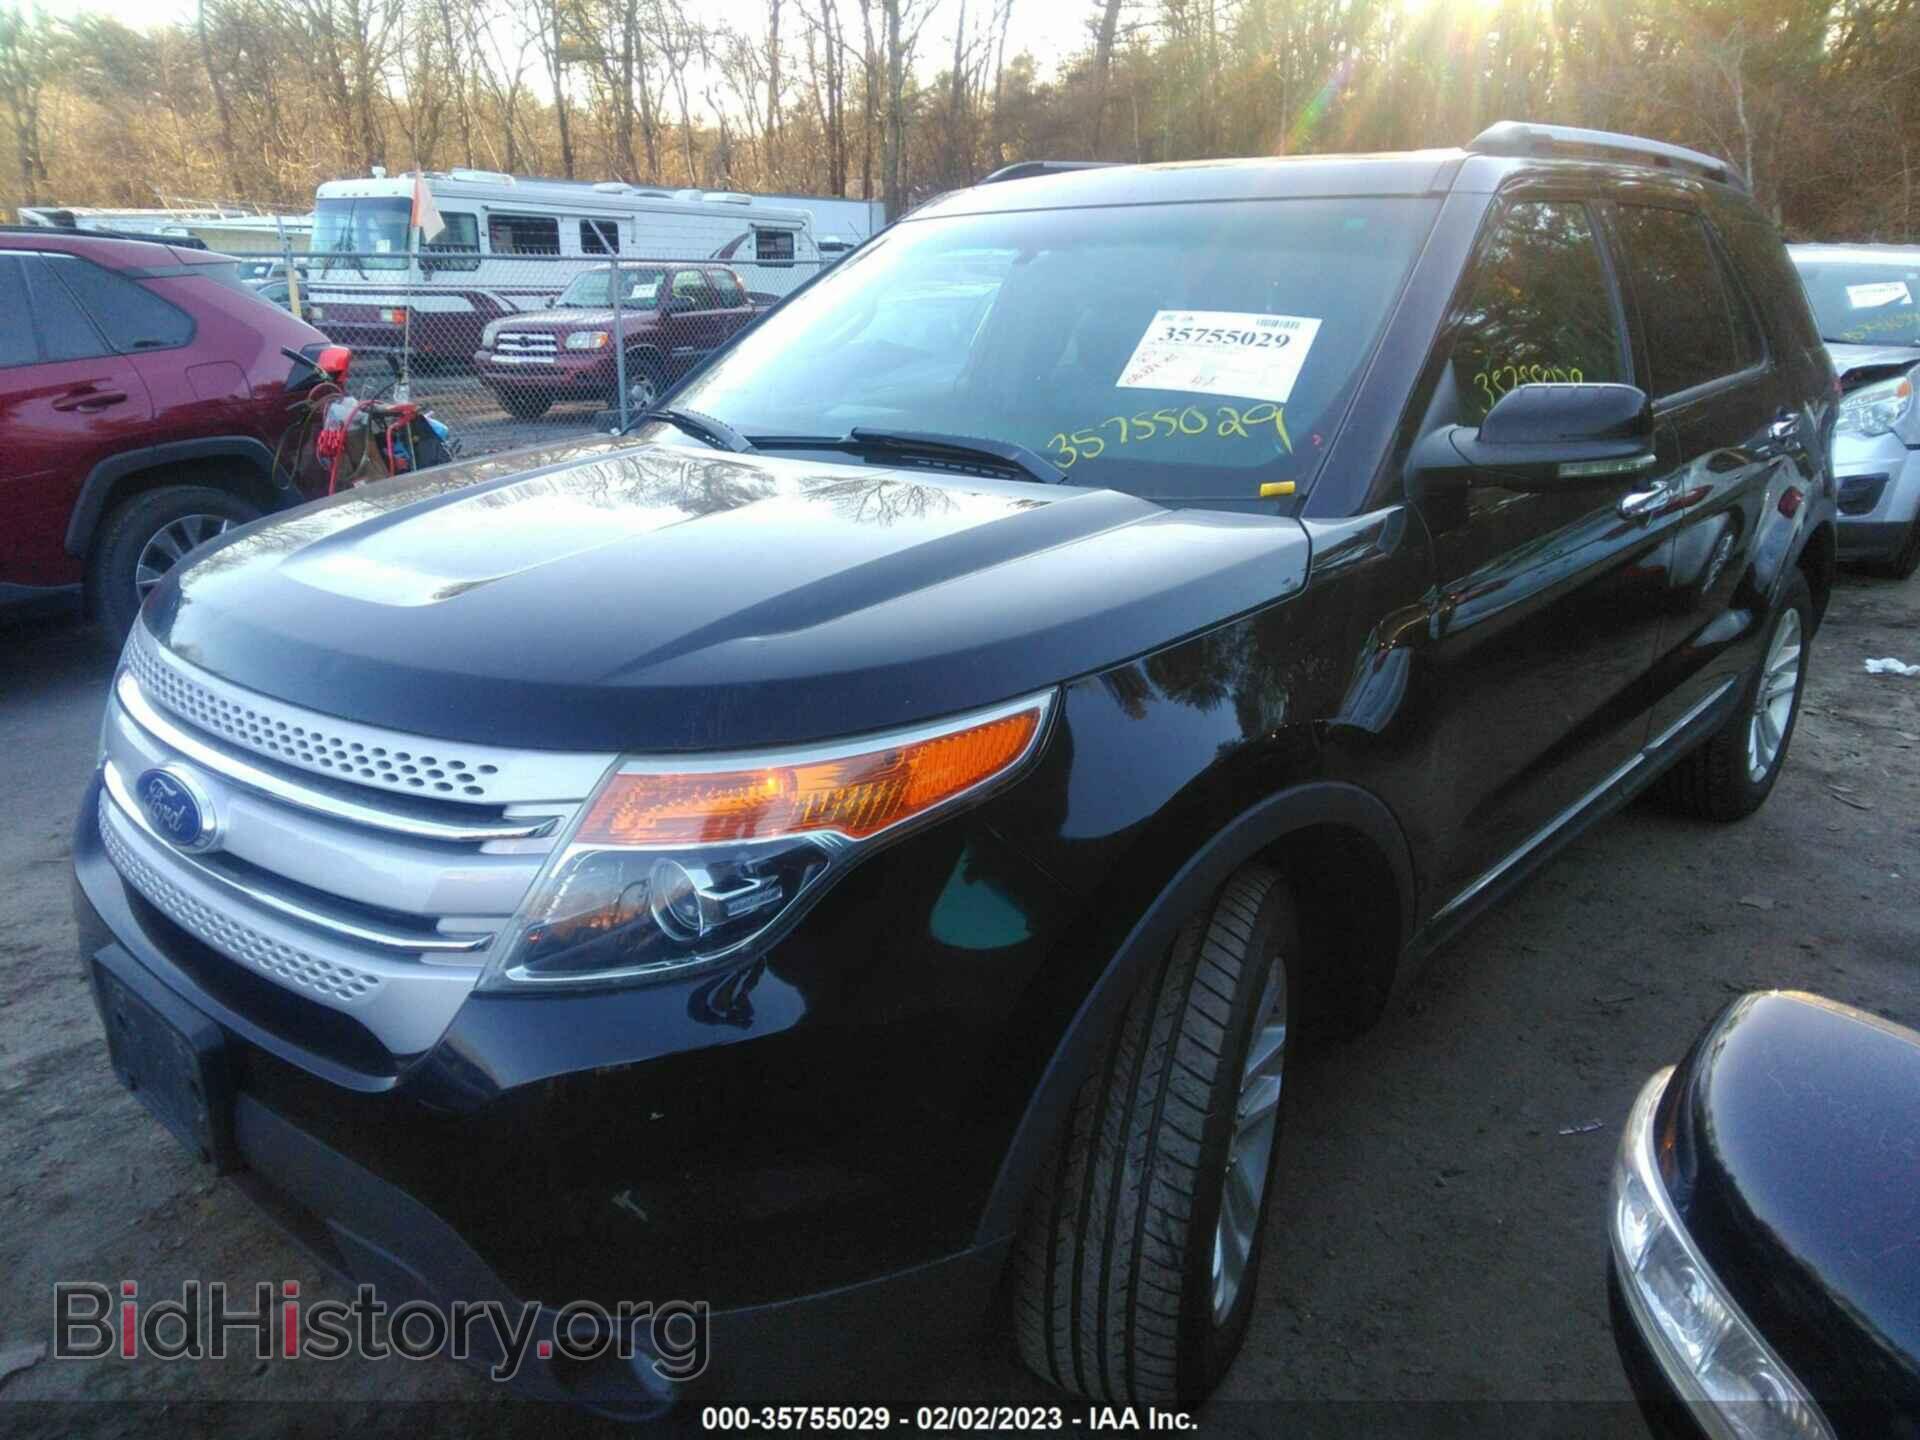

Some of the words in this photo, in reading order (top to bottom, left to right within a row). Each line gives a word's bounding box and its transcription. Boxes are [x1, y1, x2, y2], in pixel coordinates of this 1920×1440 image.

[1157, 326, 1291, 349] 35755029
[1048, 403, 1293, 469] 35755029
[144, 778, 186, 831] Ford
